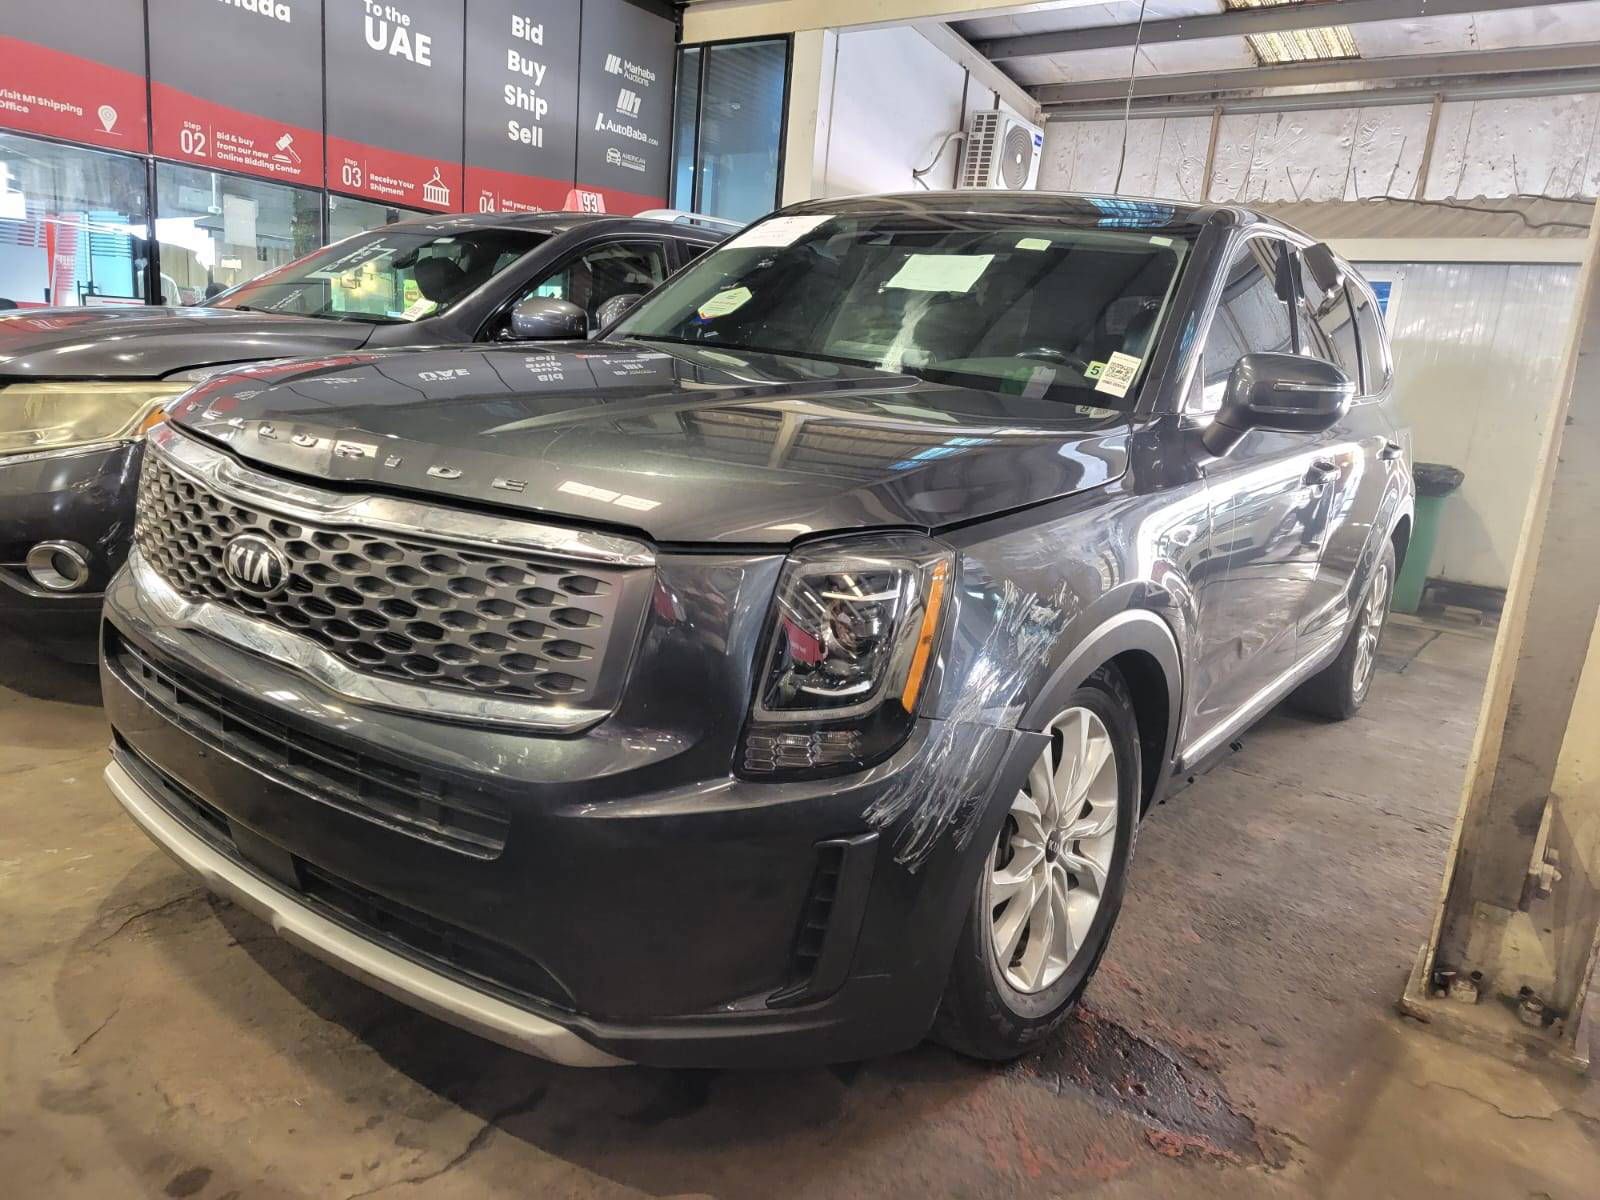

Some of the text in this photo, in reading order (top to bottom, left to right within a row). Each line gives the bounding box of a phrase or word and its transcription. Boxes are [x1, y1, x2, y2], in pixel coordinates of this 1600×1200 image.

[219, 0, 290, 23] ada
[364, 0, 410, 26] To the
[365, 16, 431, 67] UAE
[512, 14, 543, 46] Bid
[508, 48, 546, 86] Buy
[624, 60, 656, 81] Marhaba
[37, 97, 83, 116] Shipping
[504, 84, 547, 120] Ship
[183, 121, 201, 131] Step
[508, 120, 543, 148] Sell
[181, 129, 206, 157] 02
[216, 132, 230, 141] Bid
[239, 137, 254, 147] buy
[216, 141, 269, 159] from our new
[217, 152, 301, 175] Online Bidding Center
[342, 165, 361, 188] 03
[370, 173, 415, 190] Receive Your
[370, 183, 404, 196] Shipment
[479, 196, 495, 214] 04
[582, 192, 598, 213] 93
[1090, 365, 1102, 376] 5
[229, 544, 272, 588] KIA
